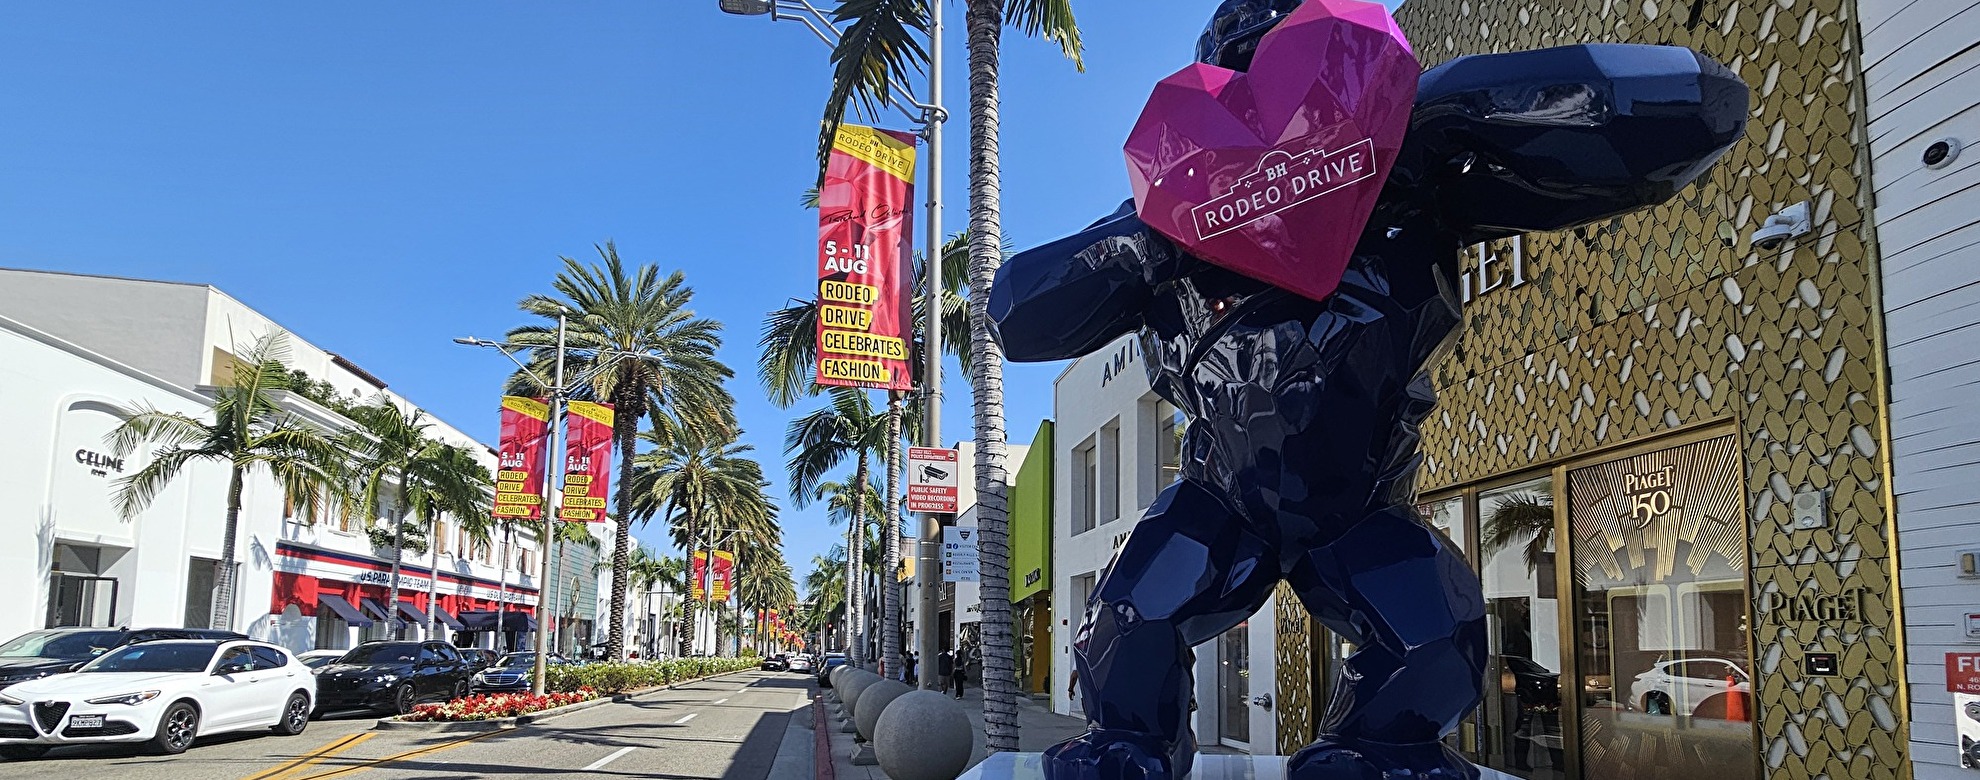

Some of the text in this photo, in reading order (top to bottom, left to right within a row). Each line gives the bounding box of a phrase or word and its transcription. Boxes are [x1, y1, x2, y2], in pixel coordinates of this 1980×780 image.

[839, 133, 904, 168] RODEO DRIVE
[1265, 161, 1288, 182] BH
[1205, 152, 1363, 229] RODEO DRIVE
[825, 240, 837, 255] 5
[854, 244, 869, 260] 11
[824, 256, 868, 275] AUG
[826, 283, 871, 303] RODEO
[825, 307, 866, 327] DRIVE
[825, 332, 901, 356] CELEBRATES
[824, 359, 880, 379] FASHION
[1102, 339, 1140, 388] AMI
[75, 449, 125, 474] CELINE
[500, 460, 523, 468] AUG
[568, 456, 574, 464] 5
[567, 464, 588, 472] AUG
[500, 471, 524, 480] RODEO
[566, 475, 589, 484] RODEO
[1625, 465, 1673, 494] PIAGET
[499, 482, 521, 491] DRIVE
[565, 486, 587, 495] DRIVE
[911, 486, 947, 495] PUBLIC SAFETY
[498, 493, 538, 504] CELEBRATES
[564, 497, 603, 507] CELEBRATES
[927, 495, 956, 503] RECORDING
[496, 506, 526, 515] FASHION
[918, 502, 944, 510] PROGRESS
[563, 509, 591, 518] FASHION
[1764, 586, 1867, 625] PIAGET
